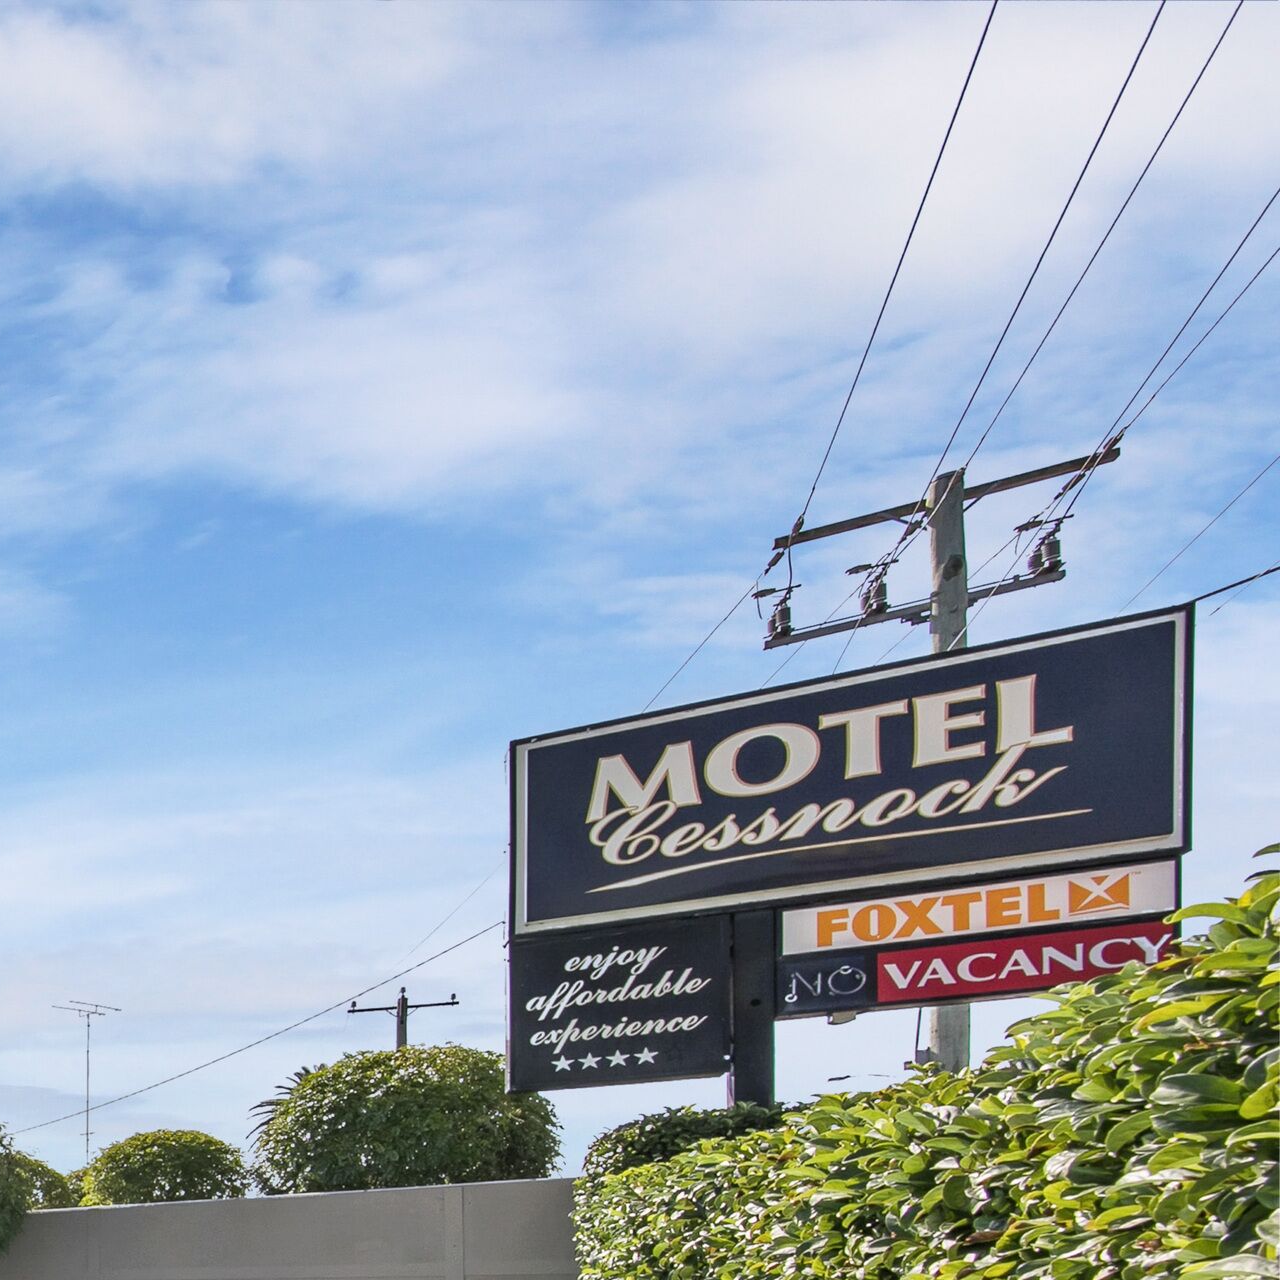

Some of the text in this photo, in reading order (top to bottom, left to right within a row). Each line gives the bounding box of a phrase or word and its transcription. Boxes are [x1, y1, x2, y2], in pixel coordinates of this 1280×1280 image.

[585, 673, 1074, 824] MOTEL
[589, 741, 1069, 865] Cessnock
[817, 883, 1060, 948] FOXTEL
[525, 967, 712, 1022] affordable
[564, 945, 668, 981] enjoy
[785, 932, 1172, 1003] NO VACANCY
[529, 1014, 709, 1055] experience
